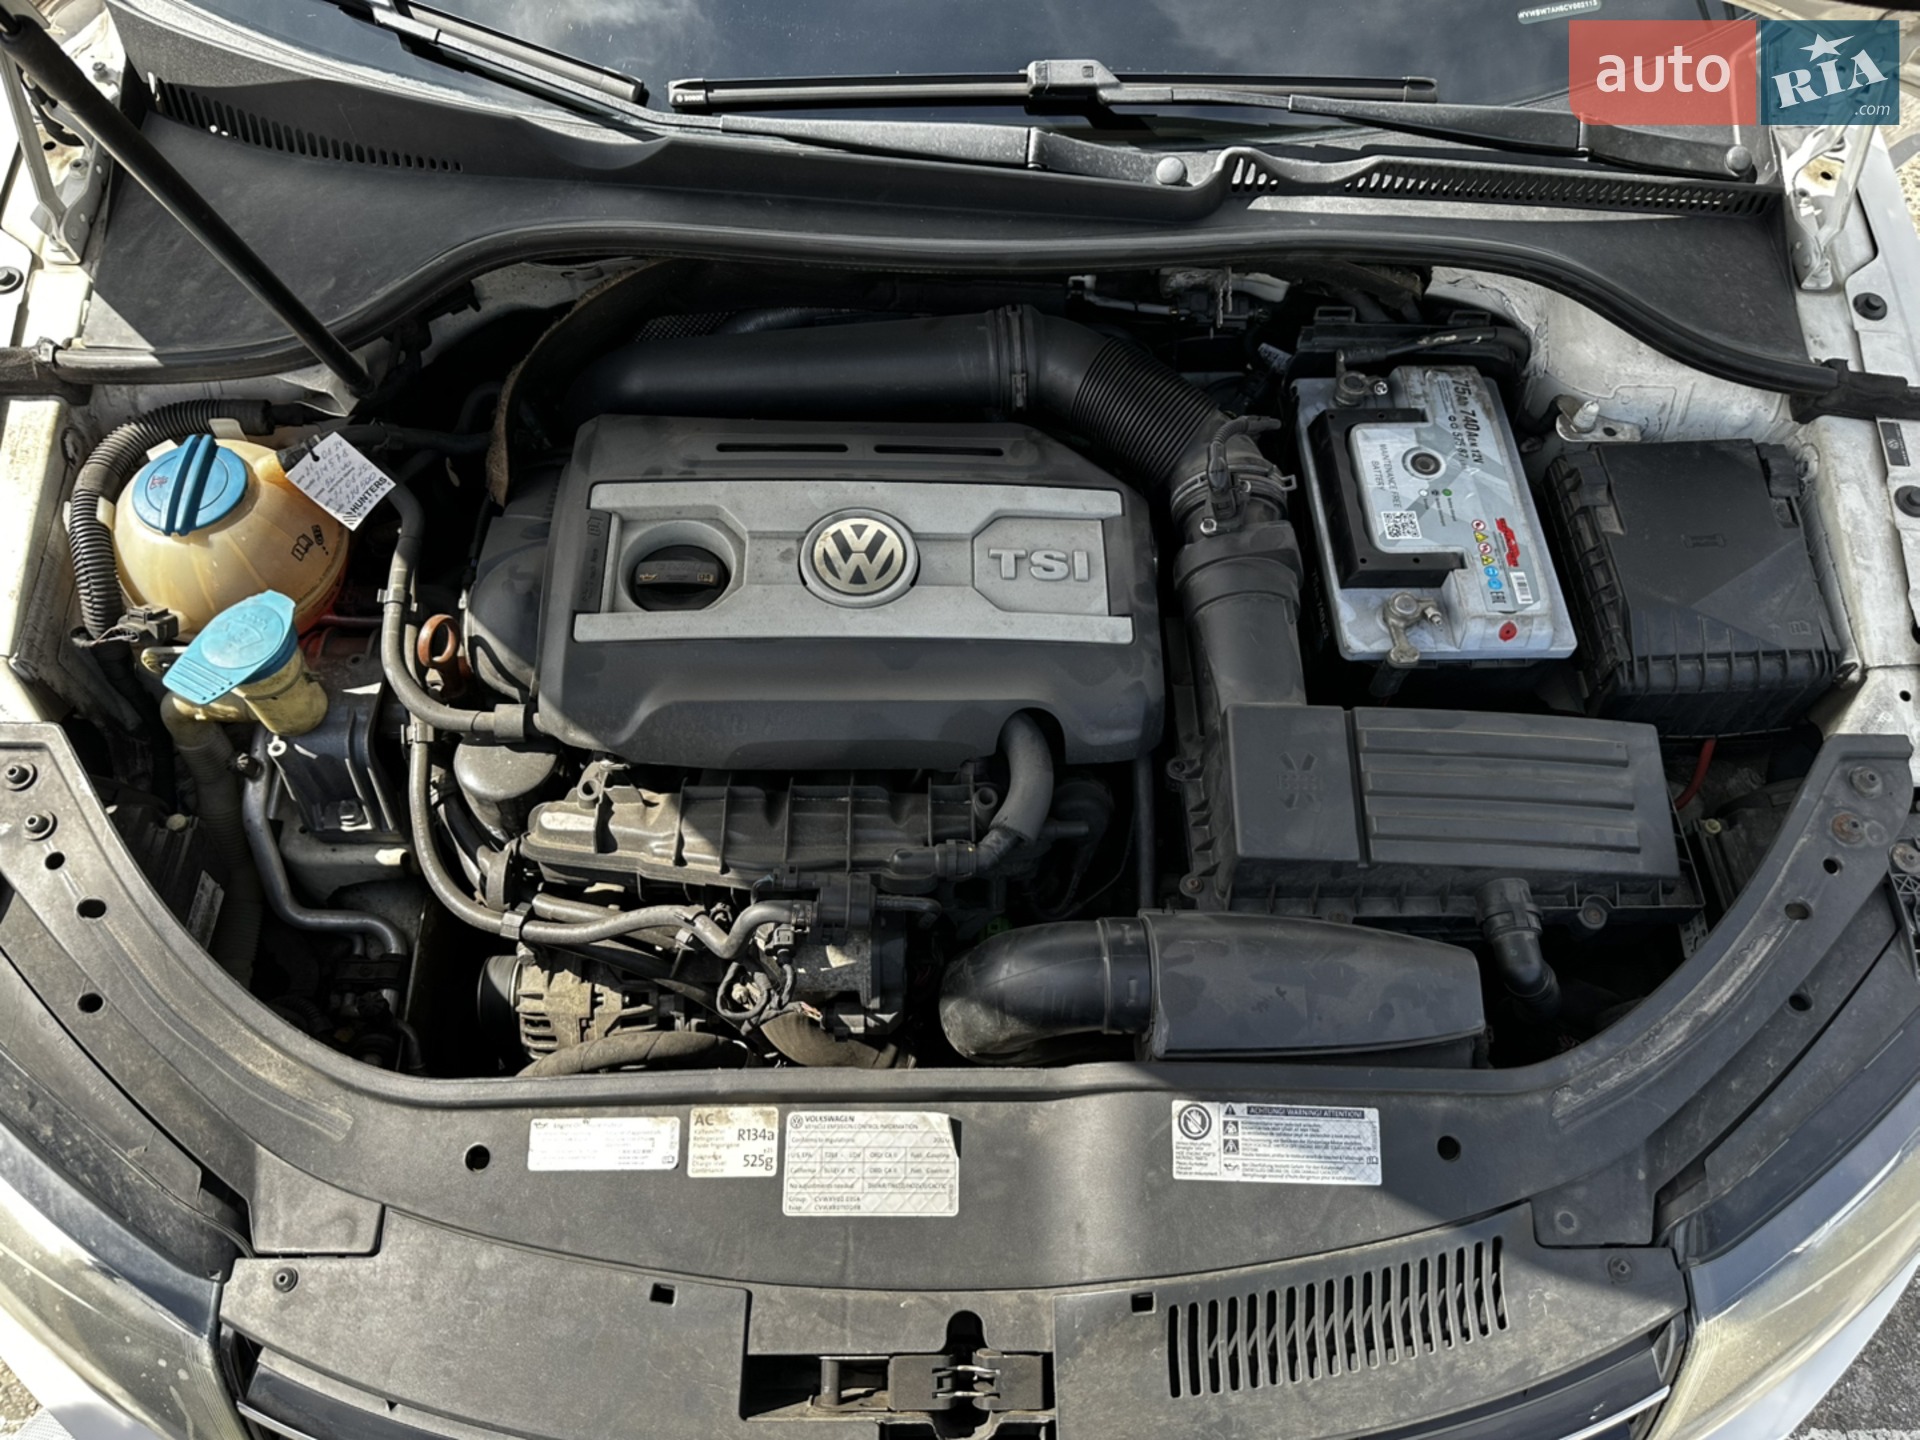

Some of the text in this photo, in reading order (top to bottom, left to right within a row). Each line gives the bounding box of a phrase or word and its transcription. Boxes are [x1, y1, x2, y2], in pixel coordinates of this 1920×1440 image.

[1371, 460, 1385, 491] BATTERY
[1380, 443, 1403, 509] MAINTENANCE FREE
[349, 476, 387, 514] HUNTERS
[988, 549, 1090, 581] TSI
[694, 1113, 714, 1126] AC
[805, 1115, 855, 1123] VOLKSWAGEN
[1286, 1109, 1321, 1117] WARNING!
[1323, 1110, 1362, 1118] ATTENTION!
[737, 1128, 775, 1141] R134a
[743, 1154, 773, 1171] 525g
